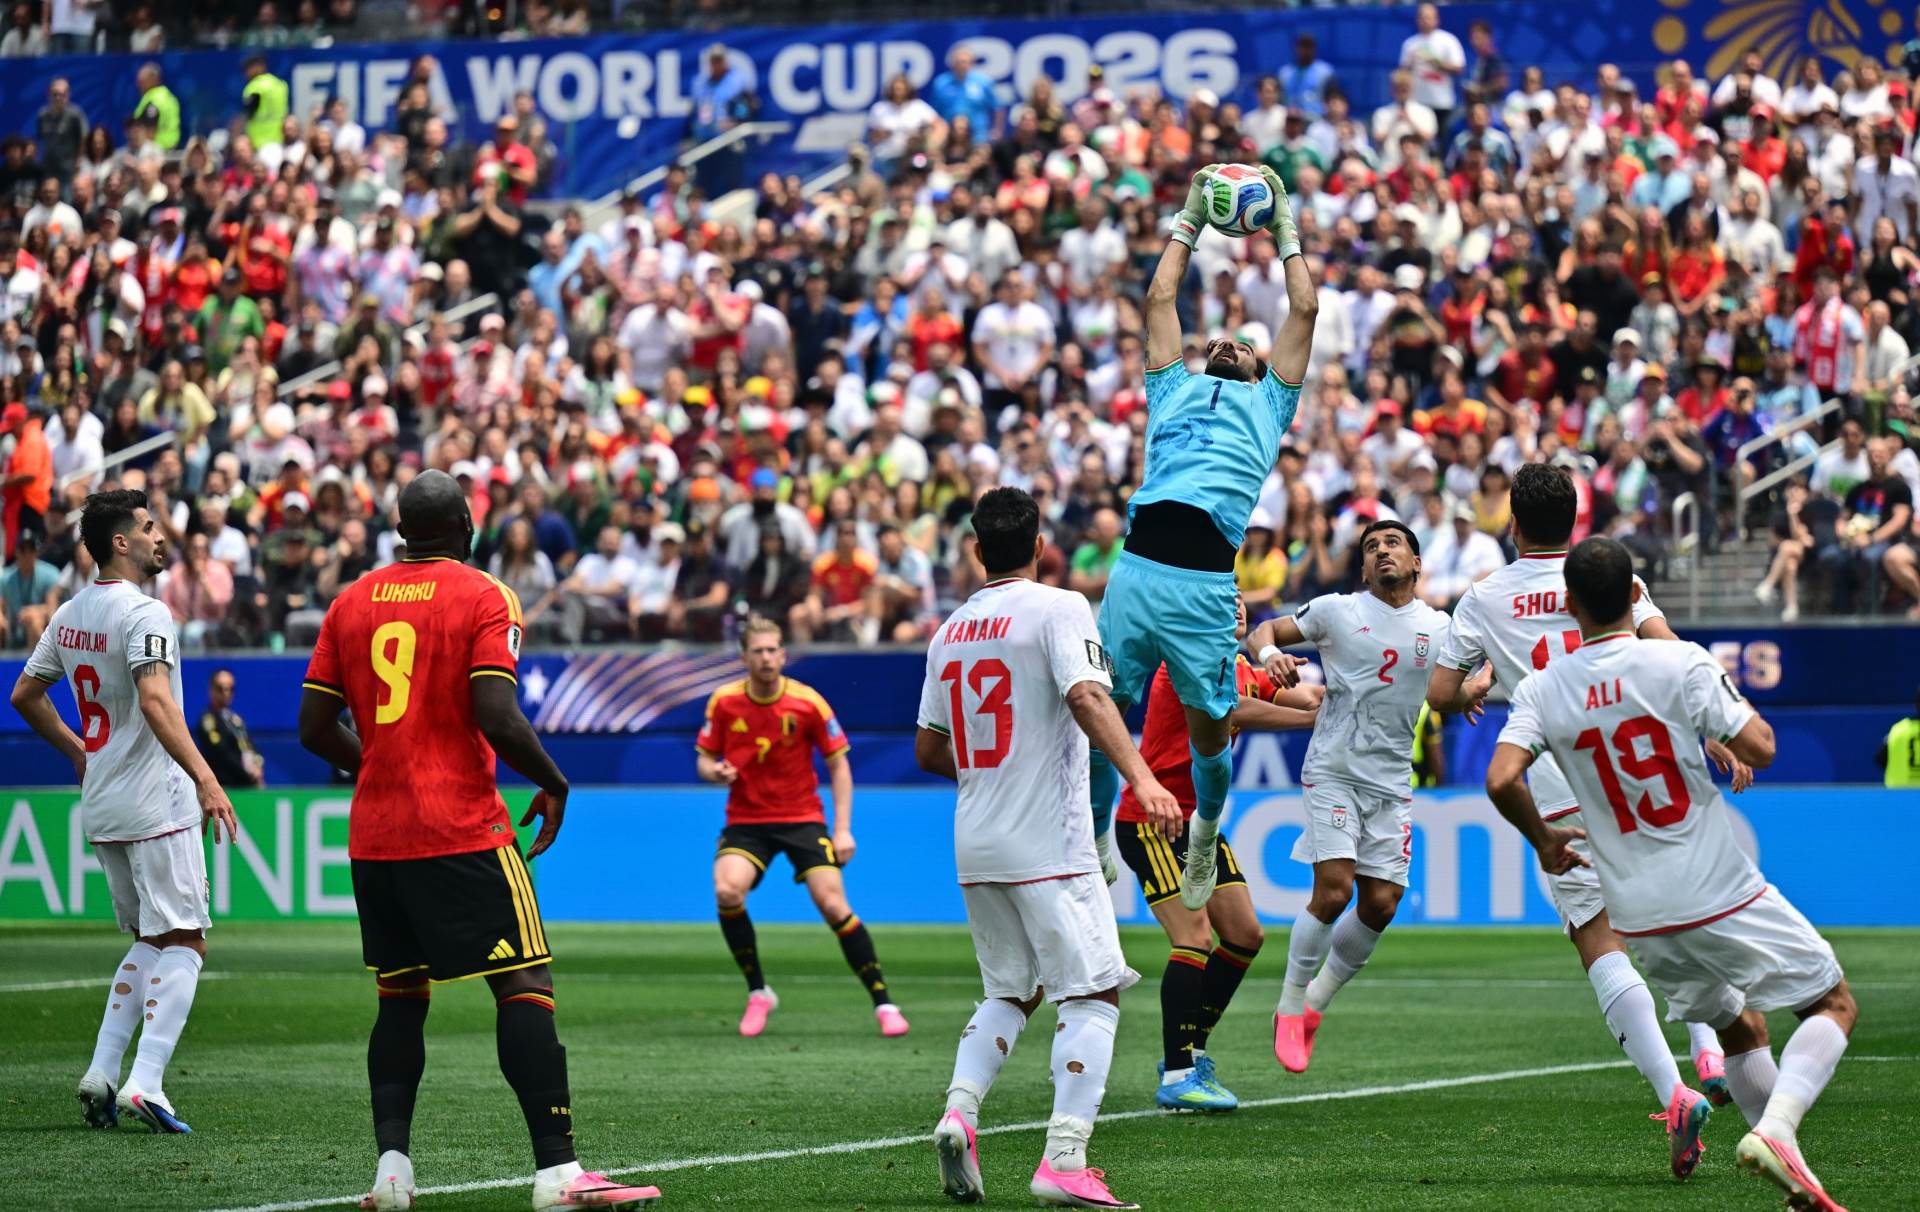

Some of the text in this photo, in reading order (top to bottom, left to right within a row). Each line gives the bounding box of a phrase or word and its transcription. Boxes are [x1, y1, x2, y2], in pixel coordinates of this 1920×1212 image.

[769, 40, 934, 114] CUP
[945, 28, 1239, 104] 2026
[1210, 380, 1223, 410] 1
[371, 581, 436, 602] LUKAKU
[944, 616, 1012, 646] KANANI
[371, 621, 416, 724] 9
[1216, 655, 1228, 687] 1
[1377, 648, 1399, 684] 2
[74, 664, 111, 752] 6
[1585, 678, 1622, 711] ALI
[939, 658, 1013, 769] 13
[755, 736, 772, 763] 7
[1573, 715, 1691, 834] 19
[817, 837, 836, 864] 7
